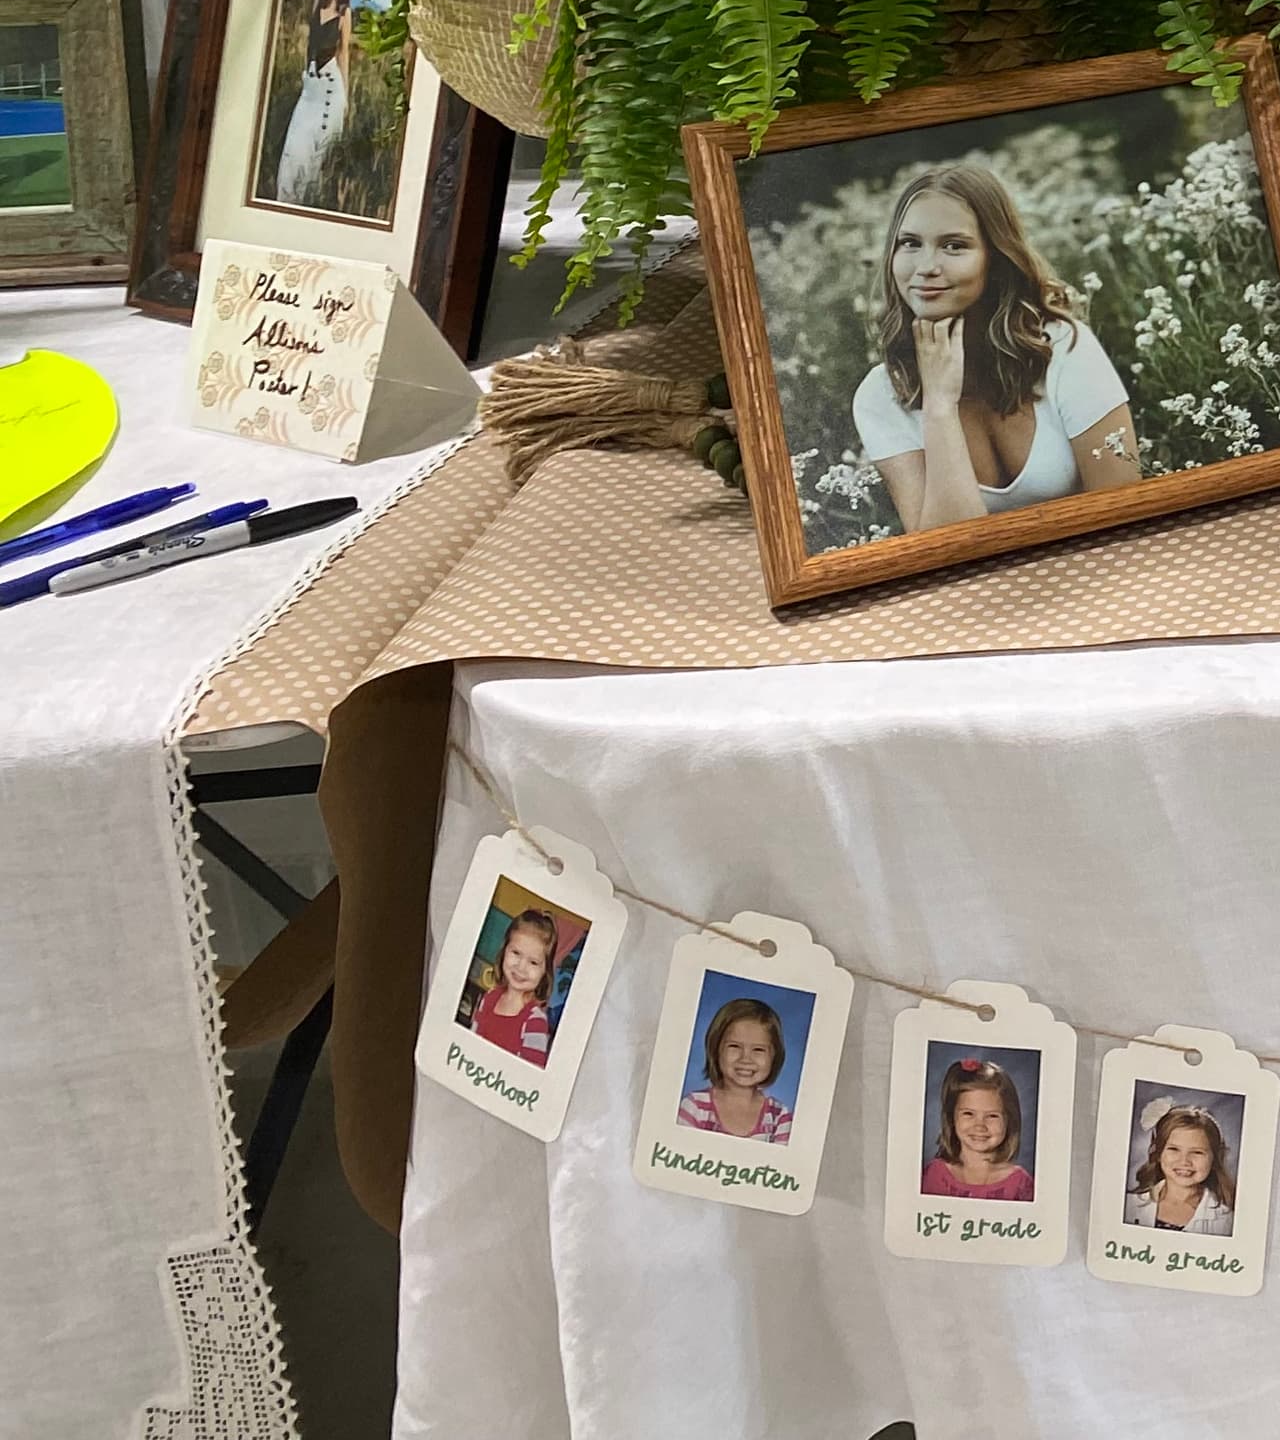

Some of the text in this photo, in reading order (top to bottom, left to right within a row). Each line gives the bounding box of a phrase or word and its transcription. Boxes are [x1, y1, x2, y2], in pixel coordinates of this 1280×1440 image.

[250, 273, 354, 327] Please sign
[242, 315, 325, 354] Allison's
[147, 536, 206, 557] Sharpie
[446, 1040, 541, 1113] Preschool
[650, 1141, 801, 1193] Kindergarten
[916, 1211, 1043, 1242] 1st grade
[1105, 1240, 1246, 1274] 2nd grade
